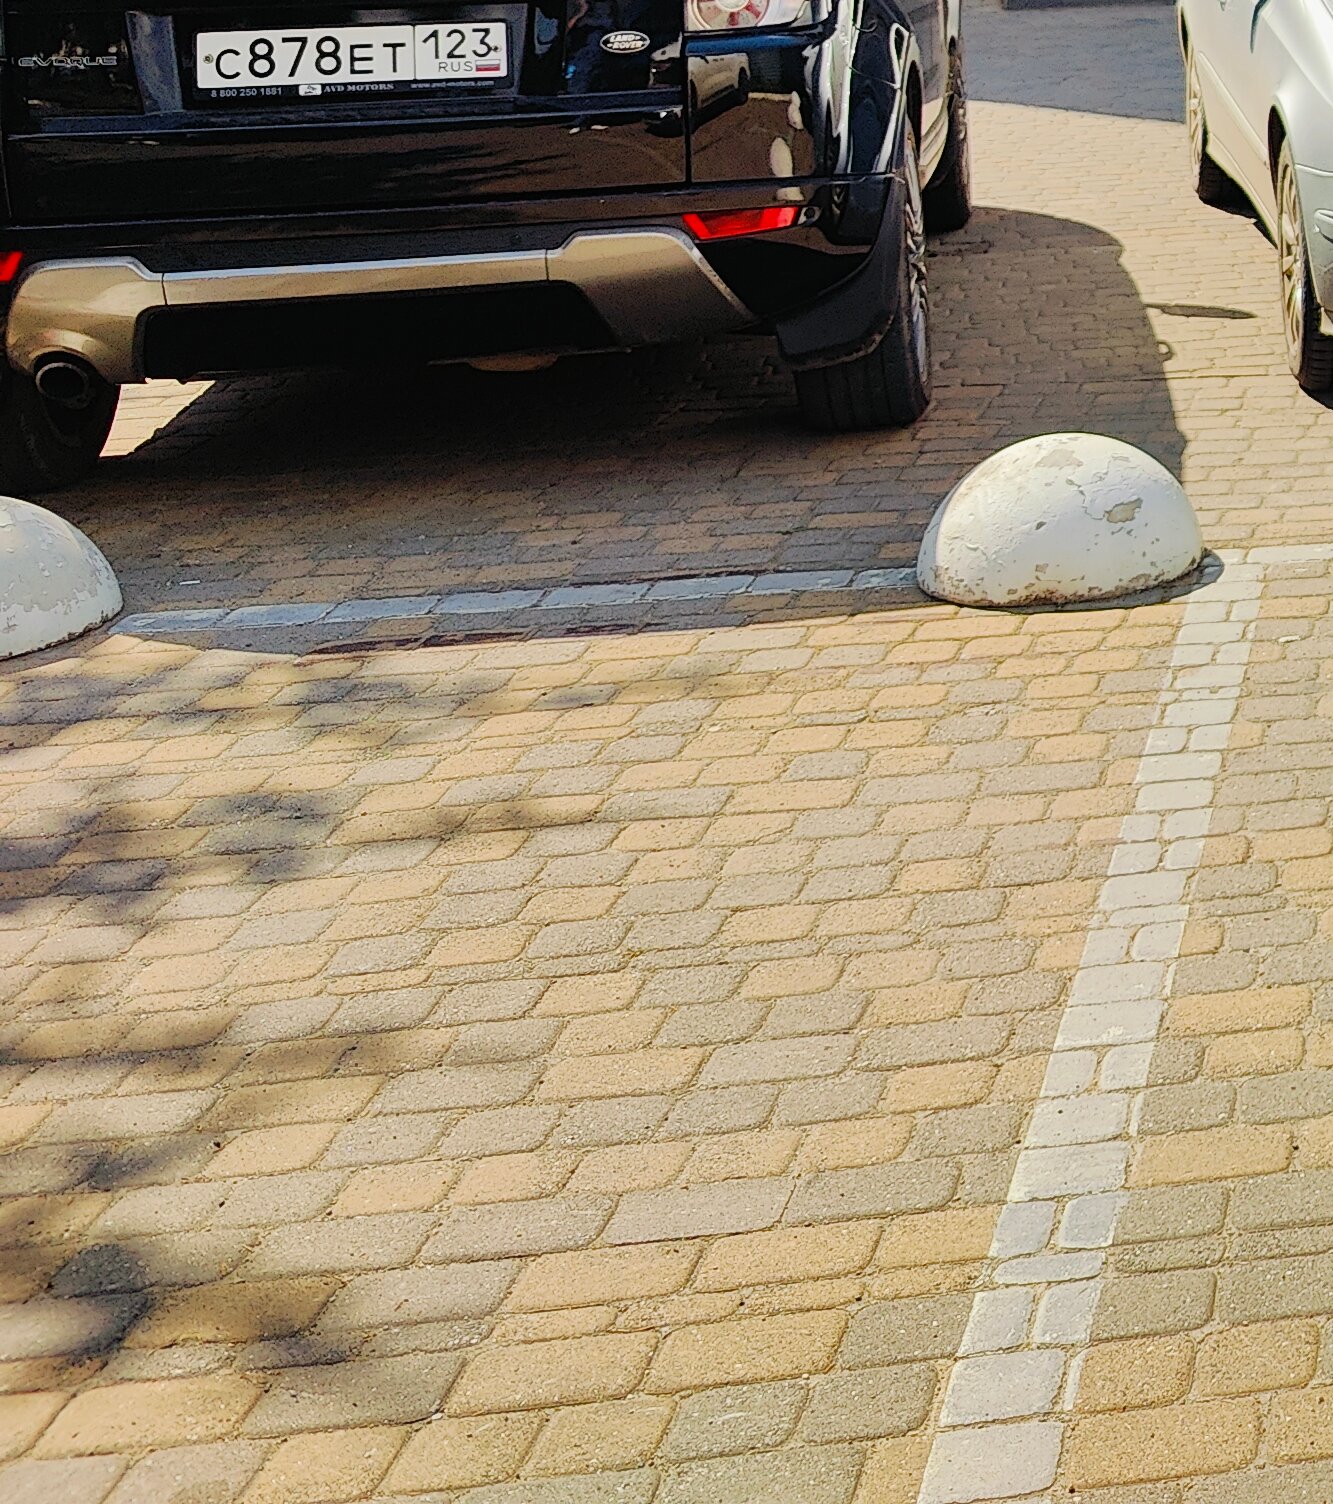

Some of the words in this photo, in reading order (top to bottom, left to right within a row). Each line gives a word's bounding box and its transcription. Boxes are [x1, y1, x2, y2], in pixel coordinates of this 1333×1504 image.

[421, 27, 494, 60] 123
[610, 34, 635, 42] LAND
[612, 41, 644, 49] ROVER
[18, 55, 118, 69] EVOQUE
[438, 60, 474, 74] RUS
[240, 87, 258, 97] 250
[323, 84, 345, 93] AVD
[346, 82, 395, 92] MOTORS
